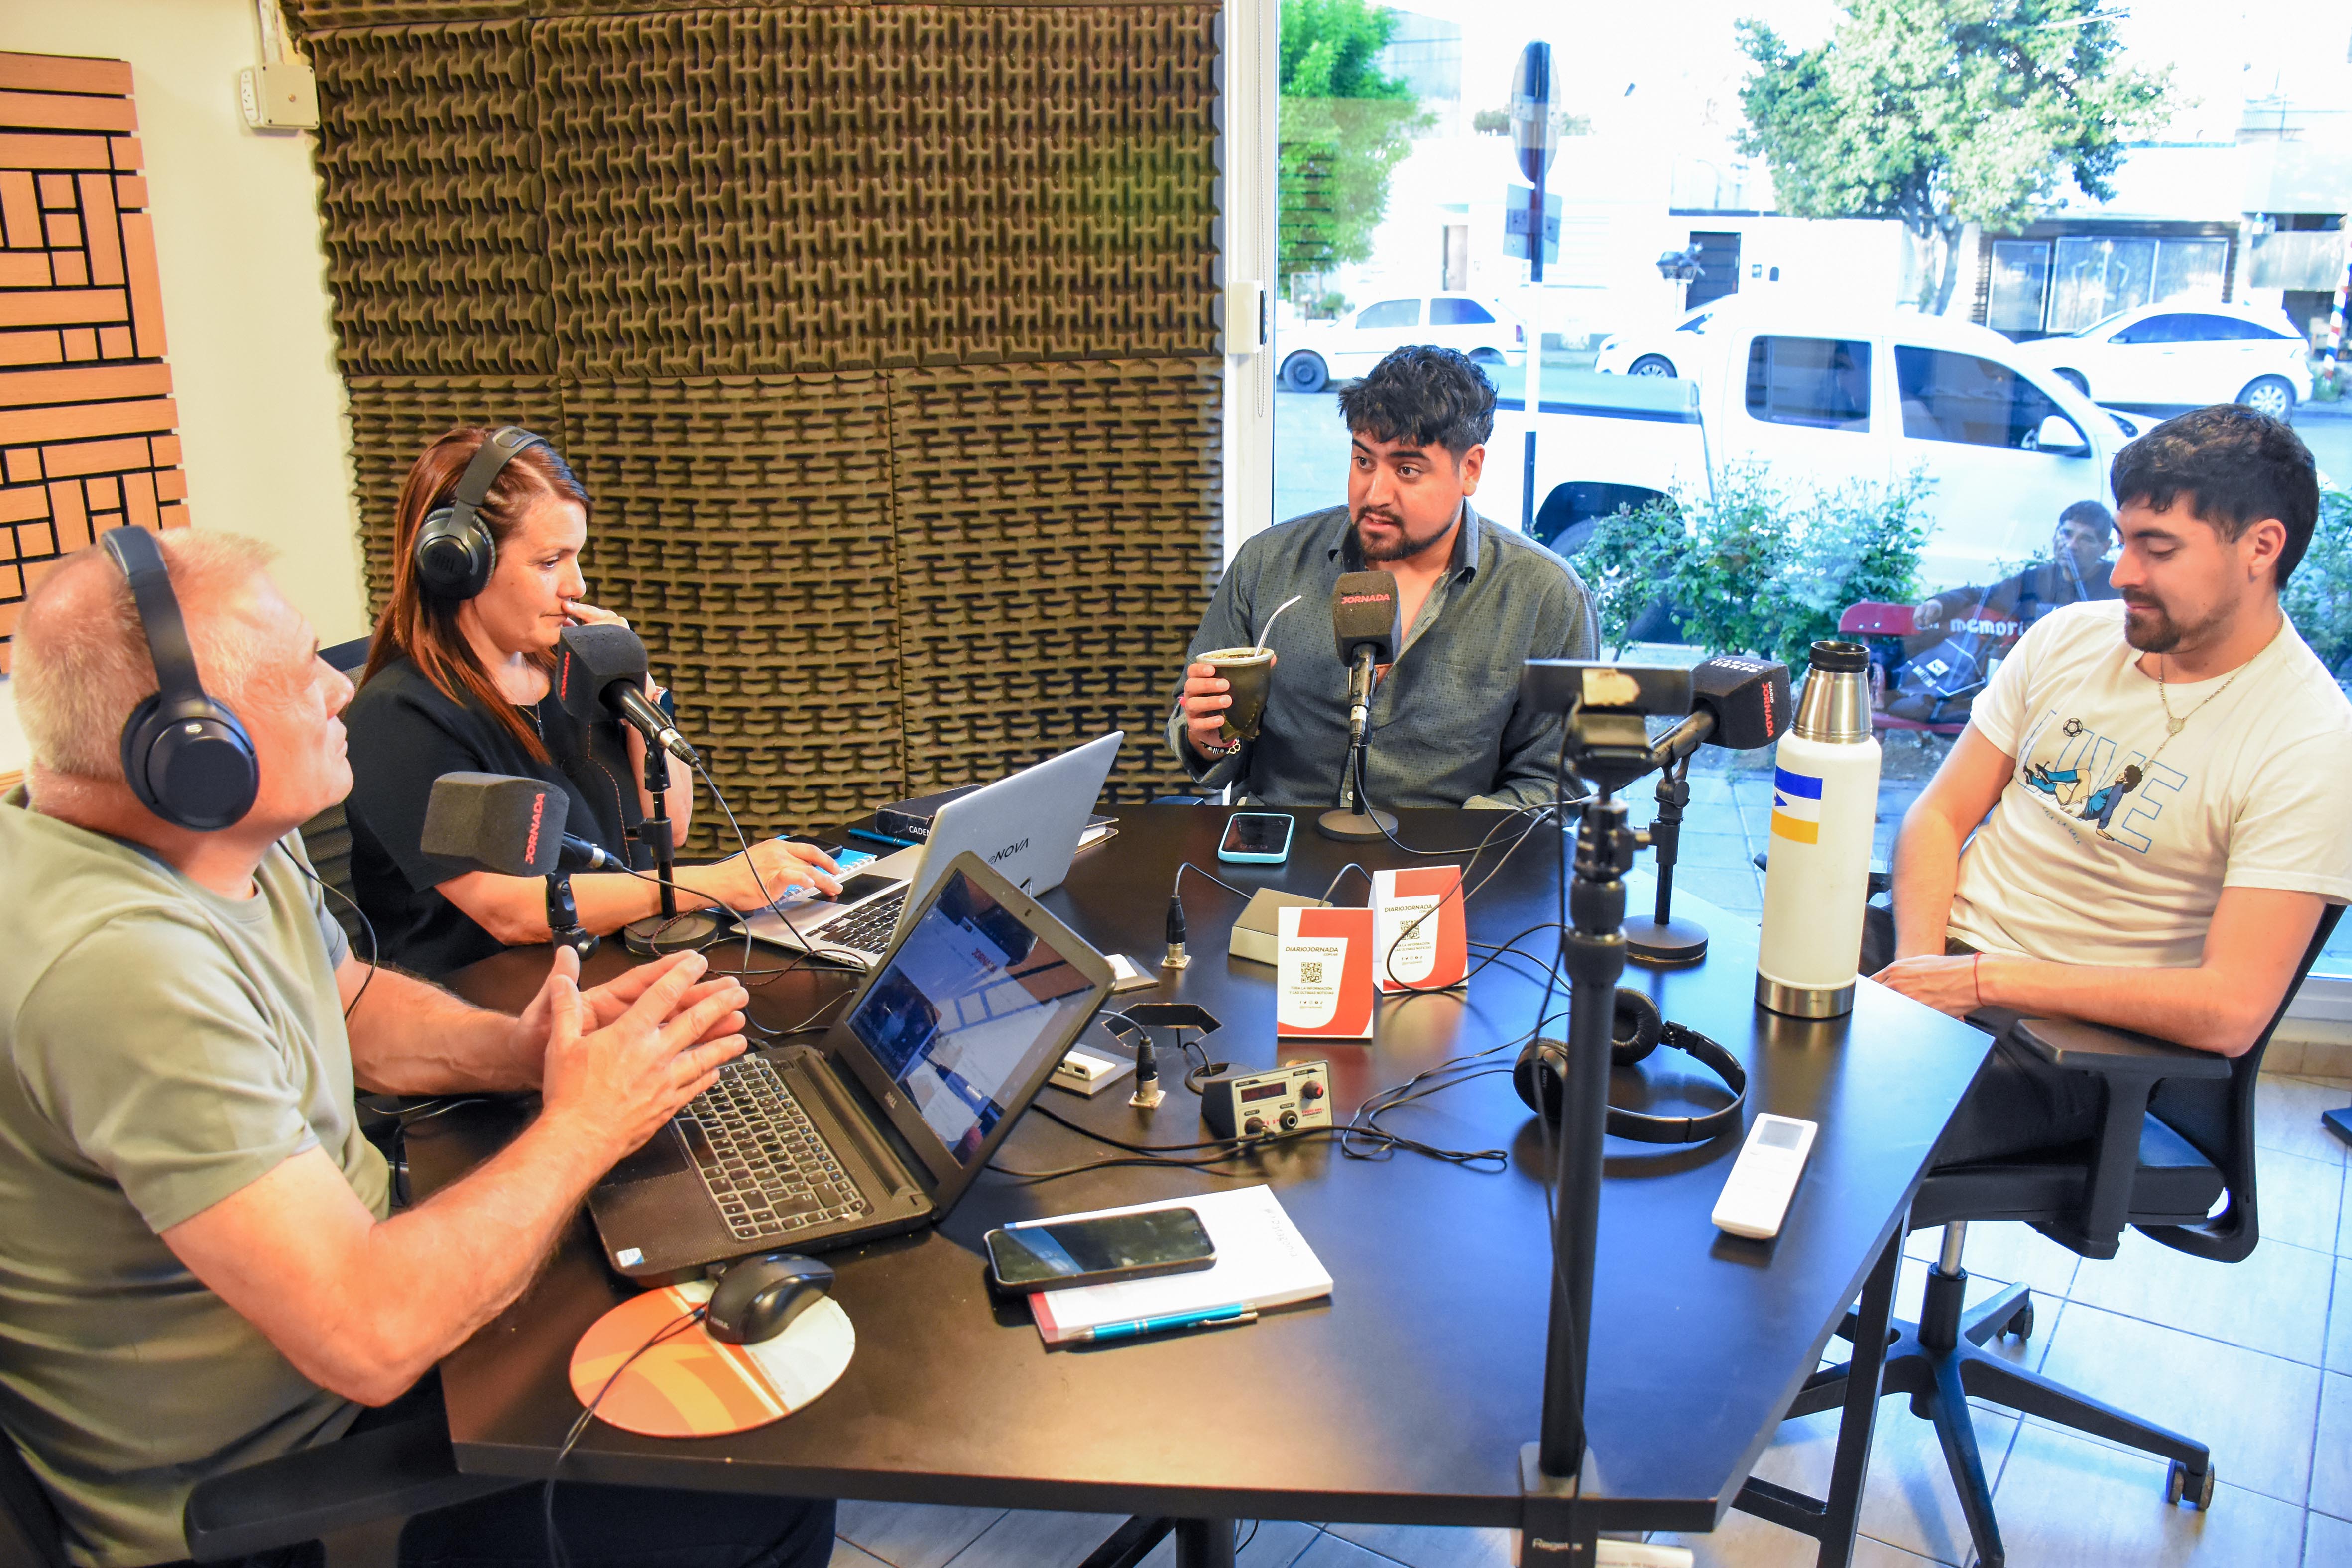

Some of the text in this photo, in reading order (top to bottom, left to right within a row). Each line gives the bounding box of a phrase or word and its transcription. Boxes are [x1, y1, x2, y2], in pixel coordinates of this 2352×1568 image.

[1341, 593, 1390, 604] JORNADA
[1950, 618, 2025, 637] memori
[1710, 661, 1758, 672] TIEMPO
[1716, 658, 1764, 670] CADENA
[561, 651, 570, 701] JORNADA
[1762, 682, 1774, 737] JORNADA
[525, 793, 546, 865] JORNADA
